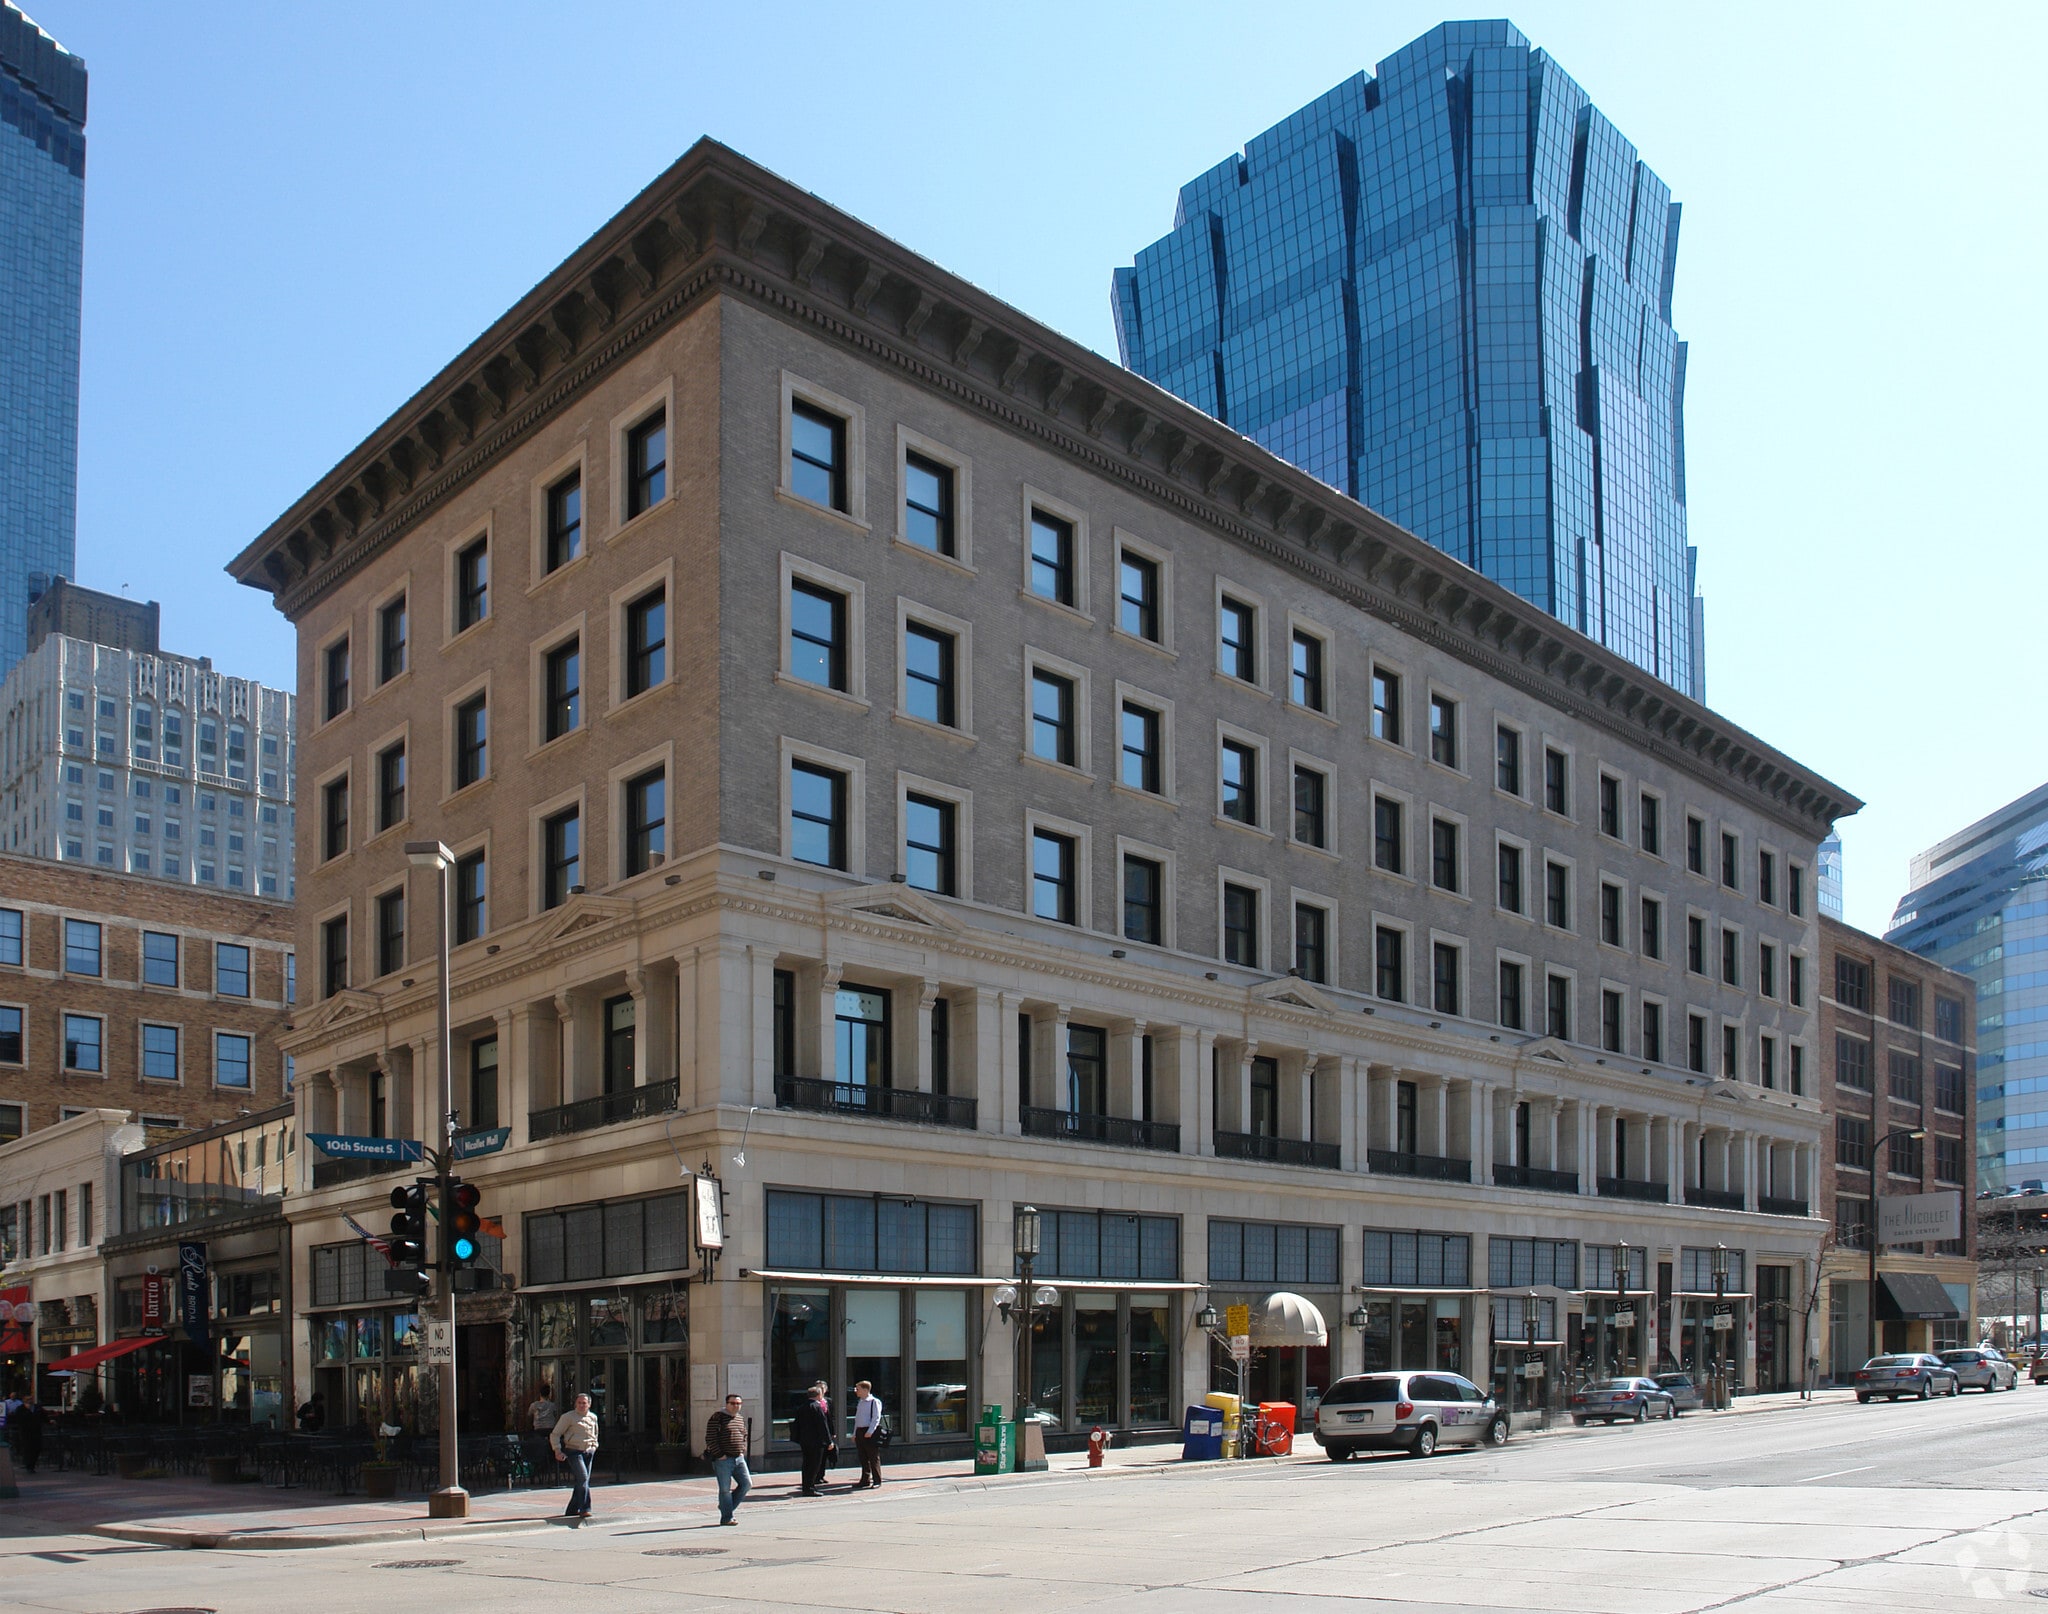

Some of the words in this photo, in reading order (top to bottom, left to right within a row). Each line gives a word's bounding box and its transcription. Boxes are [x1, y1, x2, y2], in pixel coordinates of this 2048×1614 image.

[326, 1140, 351, 1151] 10th
[353, 1142, 385, 1153] Street
[386, 1144, 396, 1154] S.
[486, 1134, 499, 1146] Mall
[1884, 1214, 1900, 1227] THE
[1905, 1203, 1950, 1225] NICOLLET
[146, 1282, 158, 1317] barrio
[187, 1295, 197, 1324] BRIDAL
[434, 1328, 444, 1340] NO
[429, 1346, 450, 1356] TURNS
